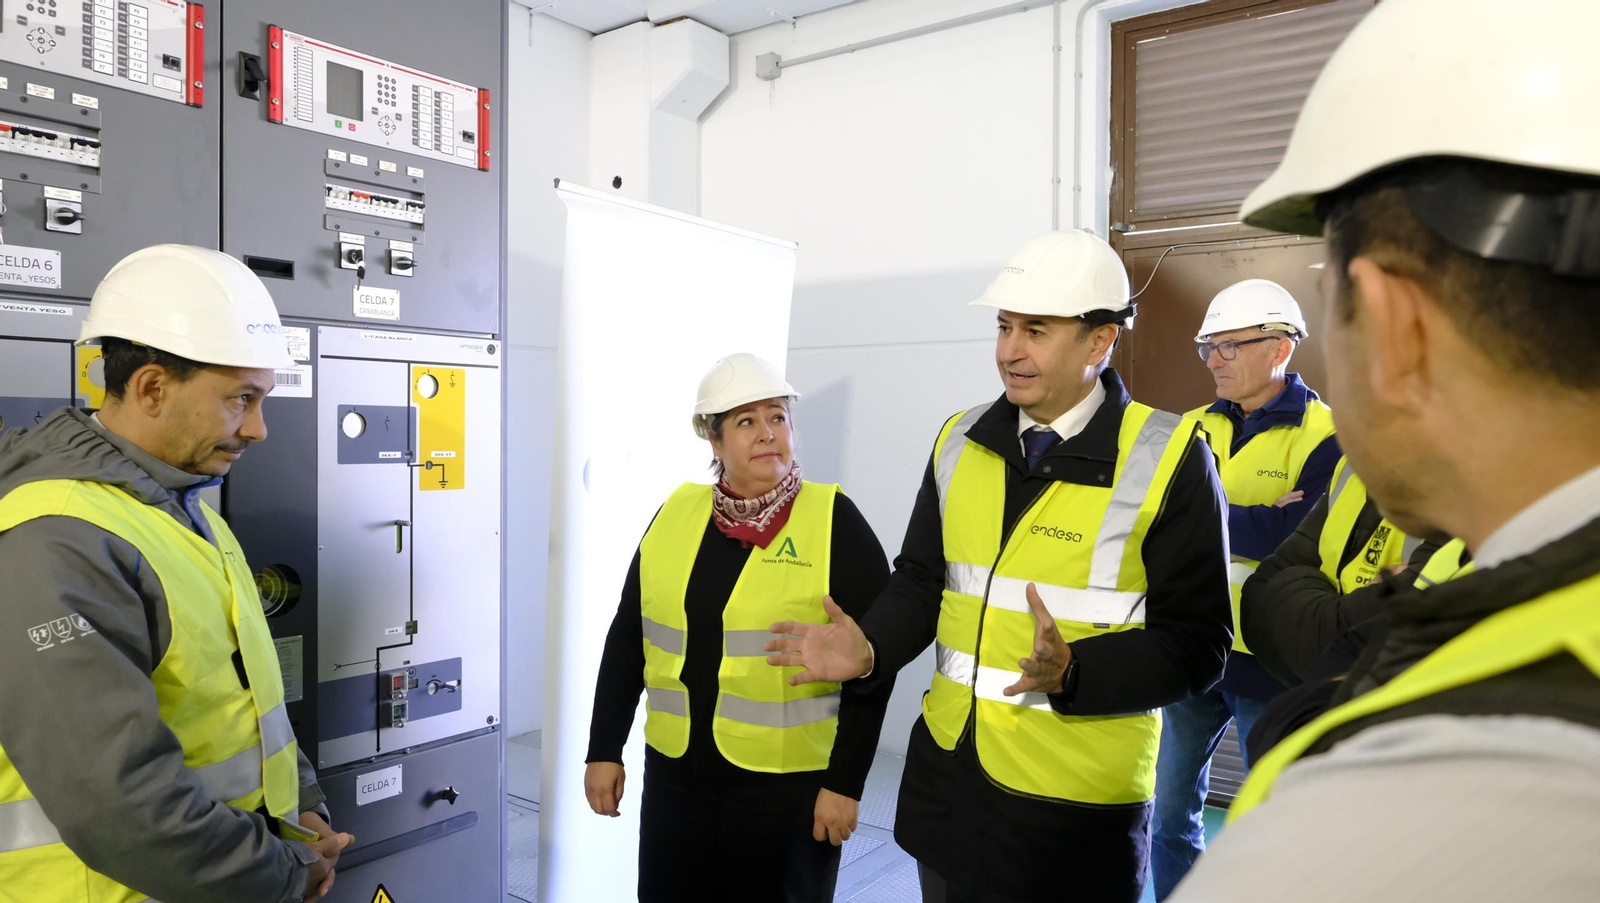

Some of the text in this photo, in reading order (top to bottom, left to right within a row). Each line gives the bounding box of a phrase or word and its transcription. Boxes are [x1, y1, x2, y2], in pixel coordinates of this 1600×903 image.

[44, 260, 53, 271] 6
[359, 294, 395, 306] CELDA 7
[359, 307, 395, 316] CASABLANCA
[1030, 525, 1083, 543] endesa
[785, 558, 812, 568] Andalucía
[361, 777, 397, 795] CELDA 7
